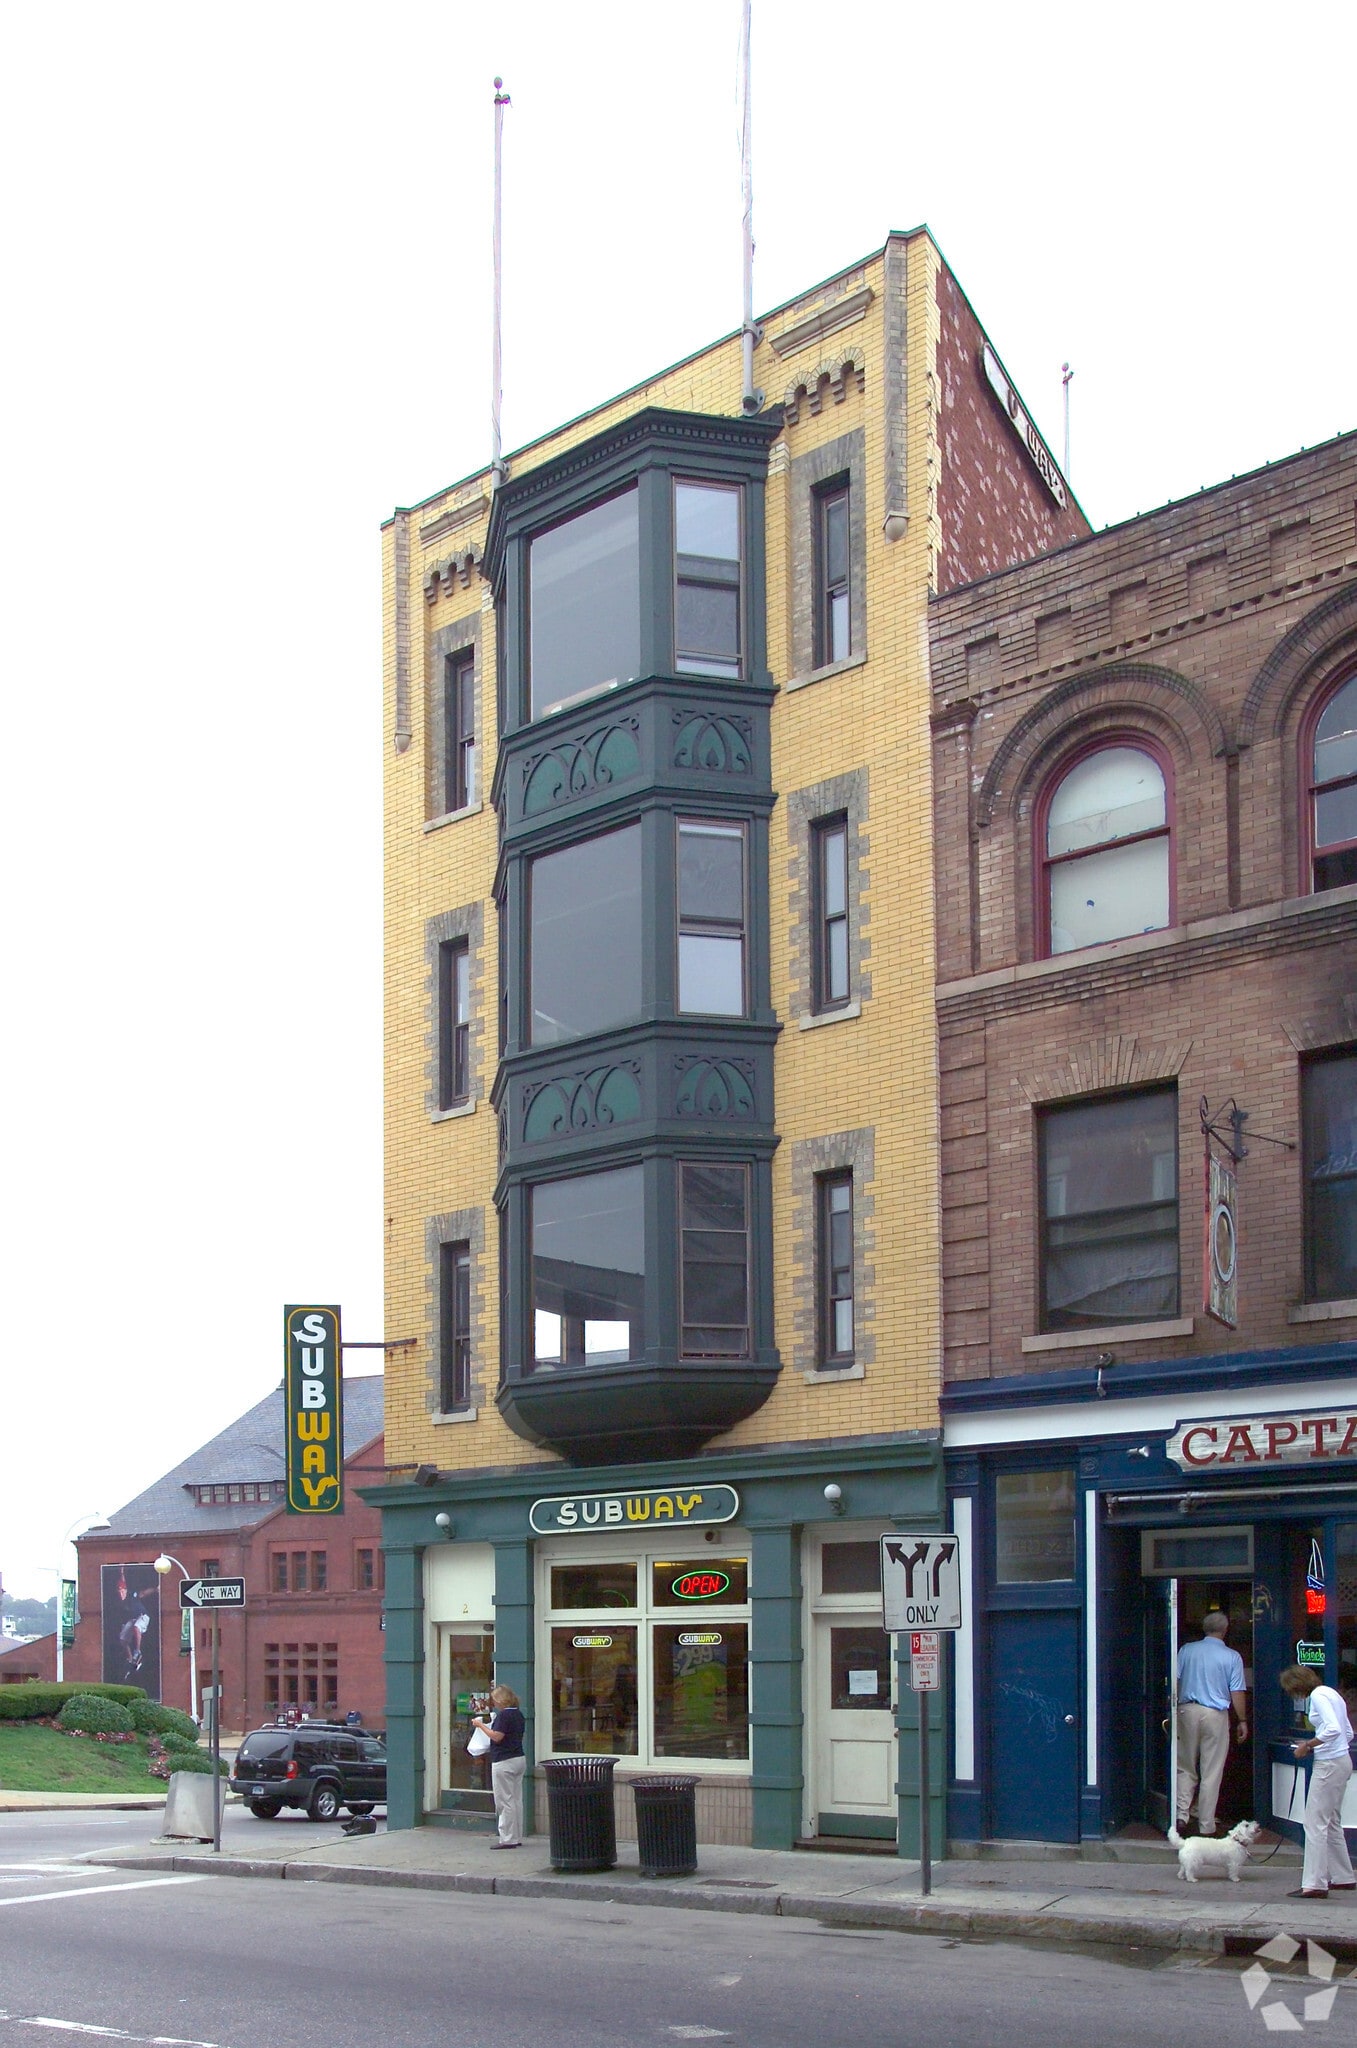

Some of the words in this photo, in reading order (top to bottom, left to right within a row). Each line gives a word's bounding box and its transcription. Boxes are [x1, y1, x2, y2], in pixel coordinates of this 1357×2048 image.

[291, 1314, 340, 1506] SUBWAY
[556, 1494, 703, 1526] SUBWAY
[679, 1575, 719, 1595] OPEN
[197, 1587, 215, 1599] ONE
[220, 1586, 239, 1598] WAY
[462, 1603, 469, 1614] 2
[906, 1604, 939, 1624] ONLY
[576, 1637, 609, 1646] SUBWAY
[682, 1633, 719, 1643] SUBWAY
[912, 1636, 920, 1649] 15
